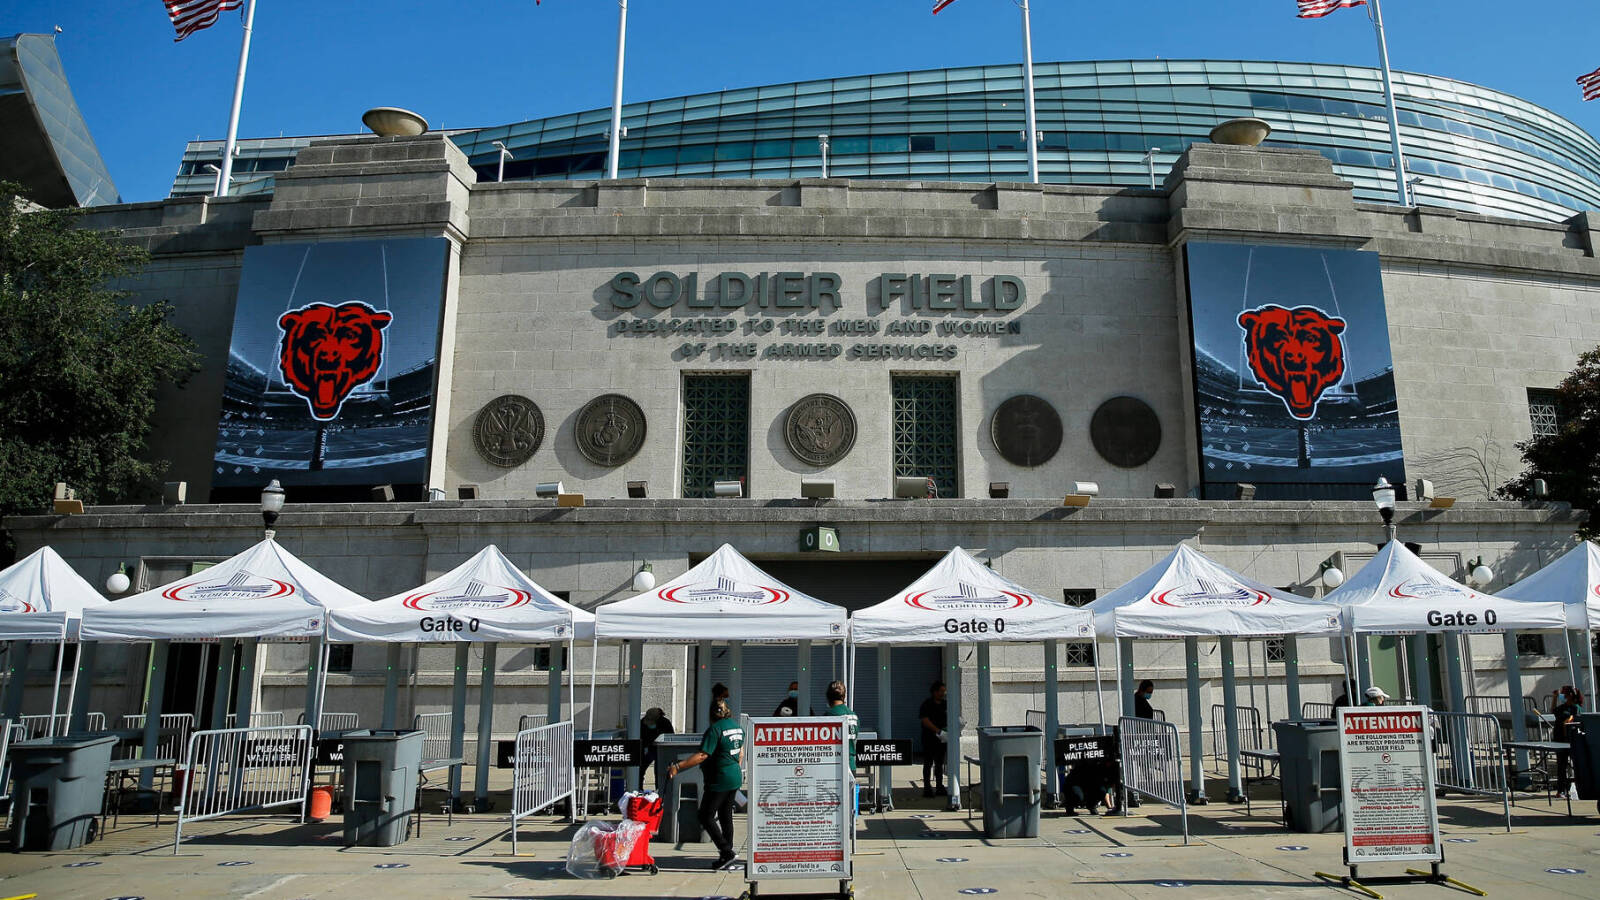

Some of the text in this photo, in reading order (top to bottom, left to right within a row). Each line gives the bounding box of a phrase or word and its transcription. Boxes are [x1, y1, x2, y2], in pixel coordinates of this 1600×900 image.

[609, 270, 1027, 311] SOLDIER FIELD
[616, 318, 1021, 334] DEDICATED TO THE MEN AND WOMEN
[681, 342, 958, 358] OF THE ARMED SERVICES
[825, 532, 833, 546] 0
[419, 616, 480, 633] Gate 0
[944, 617, 1005, 634] Gate 0
[1427, 609, 1497, 627] Gate 0
[1345, 715, 1421, 730] ATTENTION
[756, 726, 841, 742] ATTENTION
[591, 745, 625, 753] PLEASE
[864, 744, 896, 753] PLEASE
[1069, 742, 1098, 751] PLEASE
[584, 753, 631, 762] WAIT HERE
[858, 752, 903, 761] WAIT HERE
[1064, 750, 1104, 760] WAIT HERE
